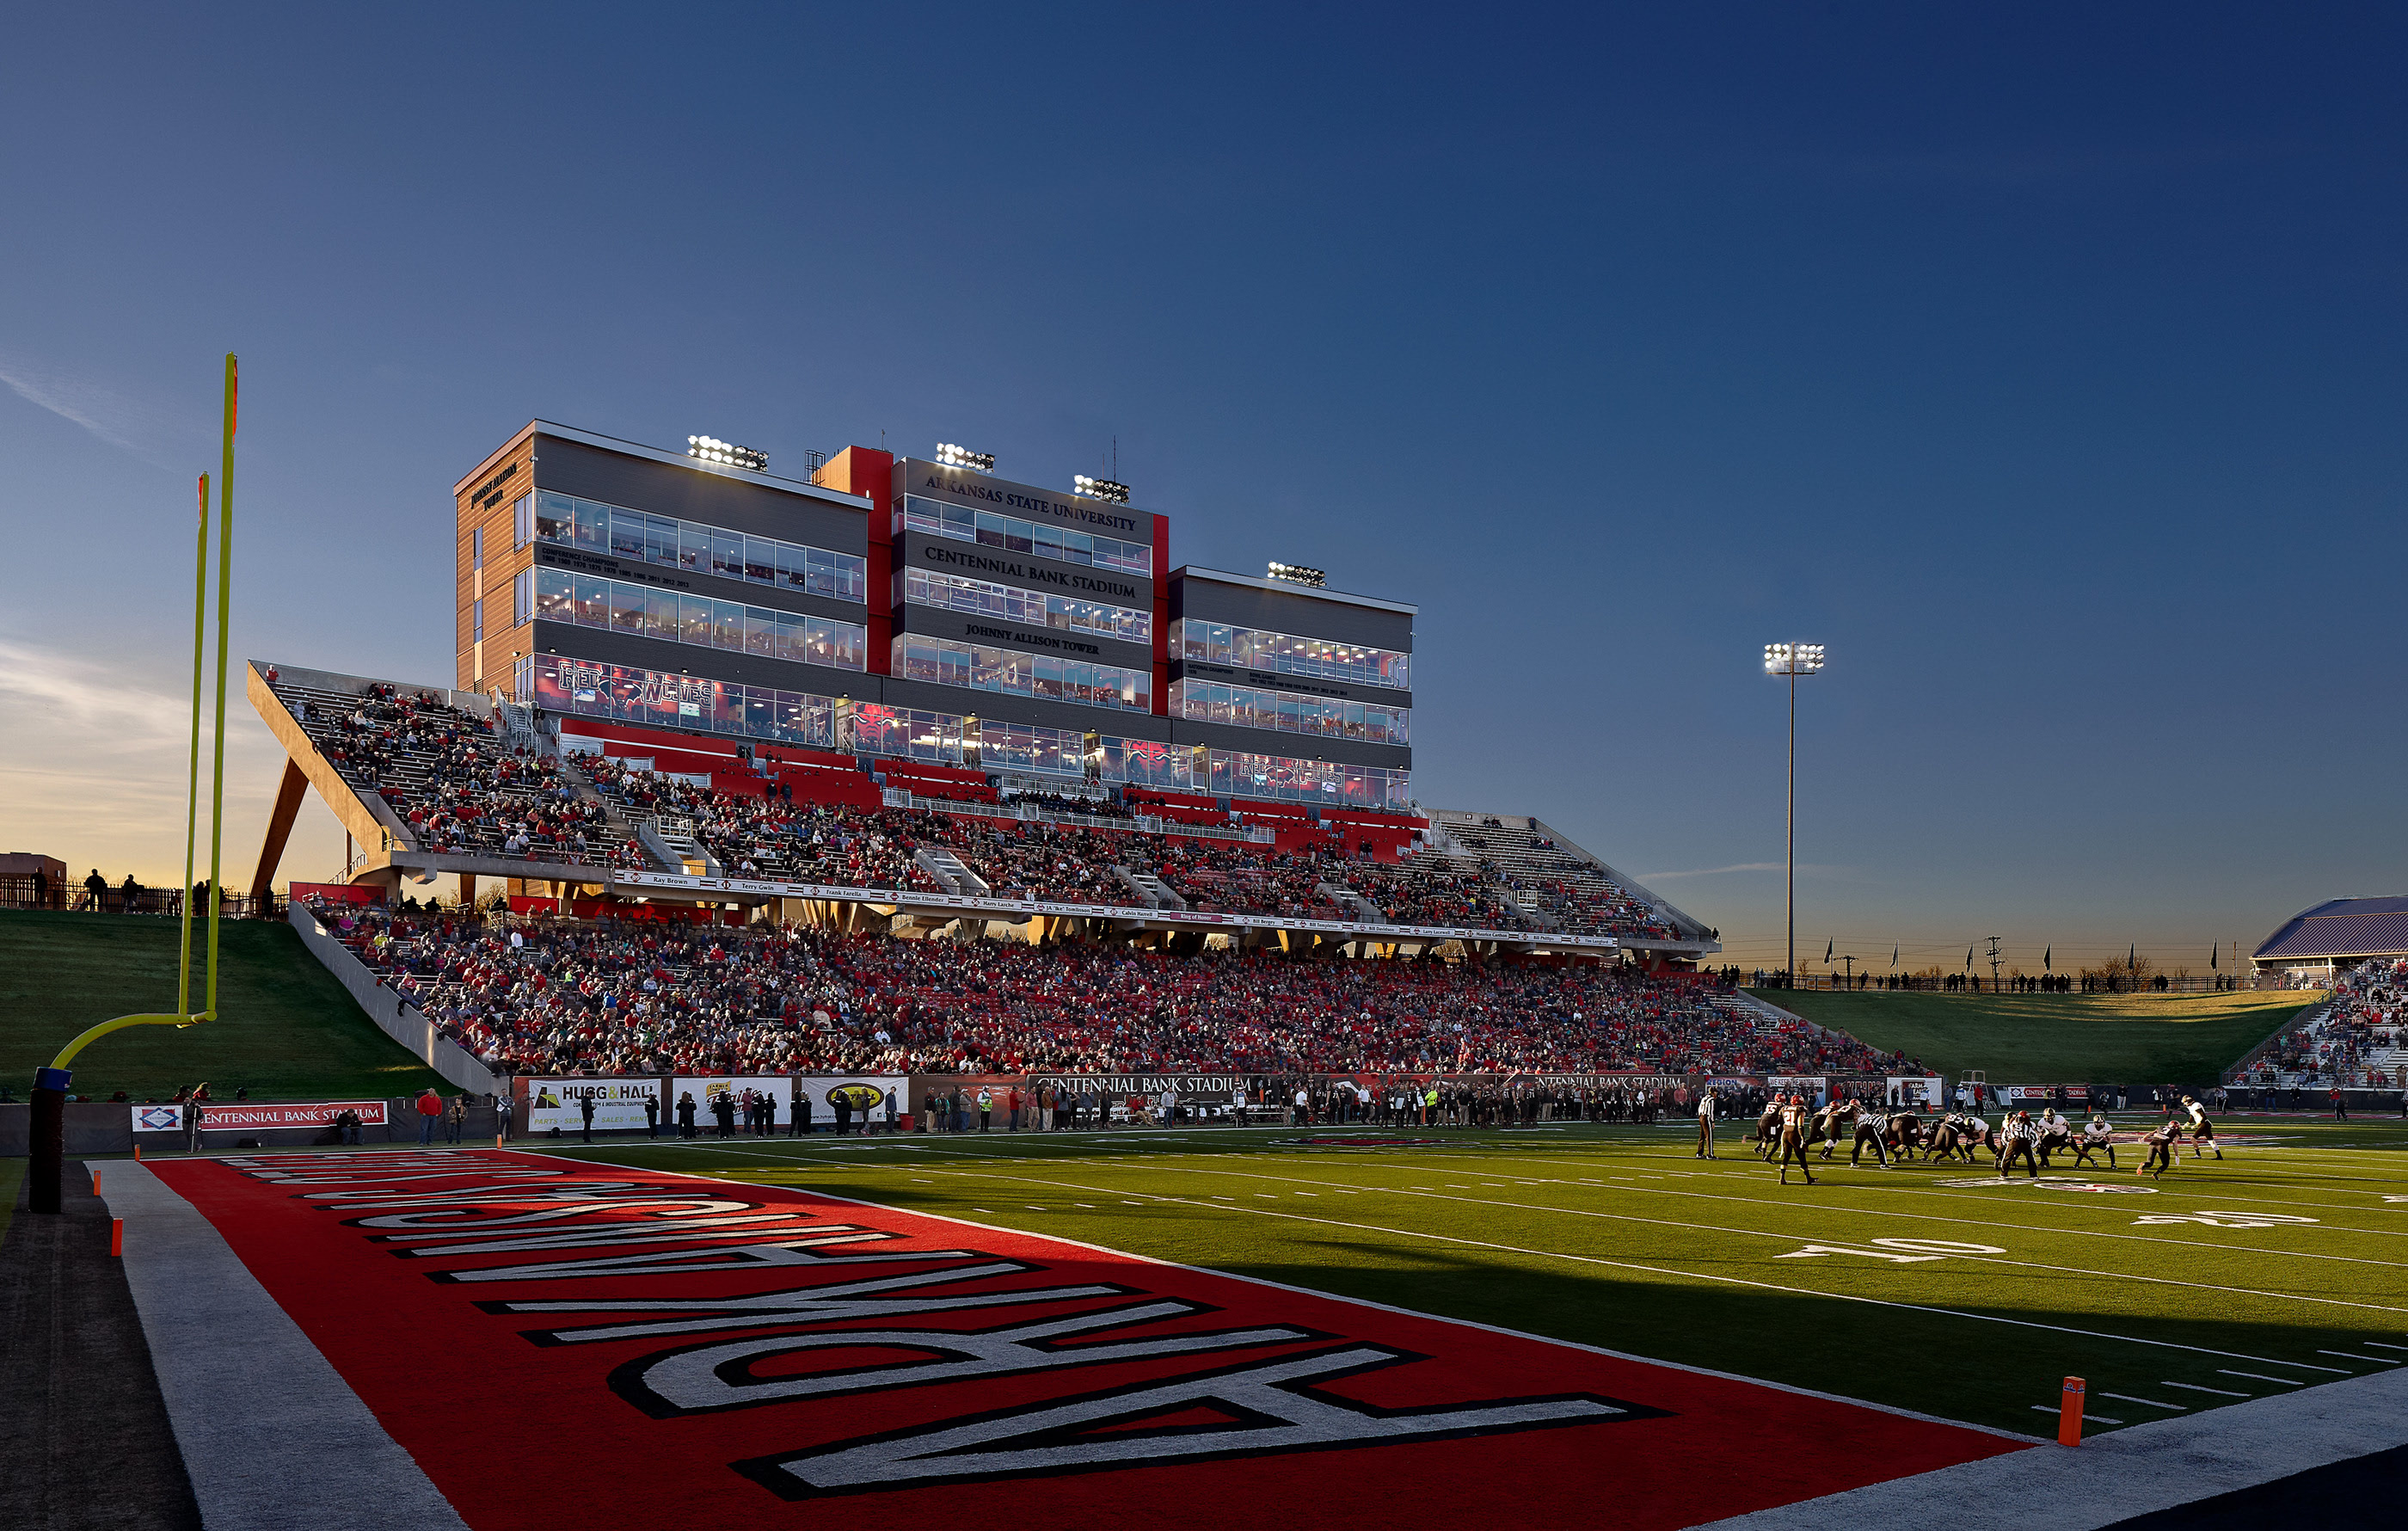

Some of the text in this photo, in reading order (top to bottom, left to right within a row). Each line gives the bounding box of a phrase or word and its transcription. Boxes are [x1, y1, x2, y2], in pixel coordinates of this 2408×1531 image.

[926, 476, 1136, 532] ARKANSAS STATE UNIVERSITY
[542, 547, 619, 568] CONFERENCE CHAMPIONS
[925, 546, 1135, 598] CENTENNIAL BANK STADIUM
[966, 624, 1099, 655] JOHNNY ALLISON TOWER
[559, 661, 716, 710] RED WOLVES
[1239, 754, 1269, 778] RED
[654, 876, 665, 885] Ray
[742, 882, 758, 891] Terry
[1142, 1078, 1182, 1092] BANK
[201, 1109, 379, 1123] ENTENNIAL BANK STAUM
[1784, 1110, 1796, 1126] 21
[1772, 1238, 2007, 1263] 10
[289, 1182, 1678, 1502] ARKANSAS
